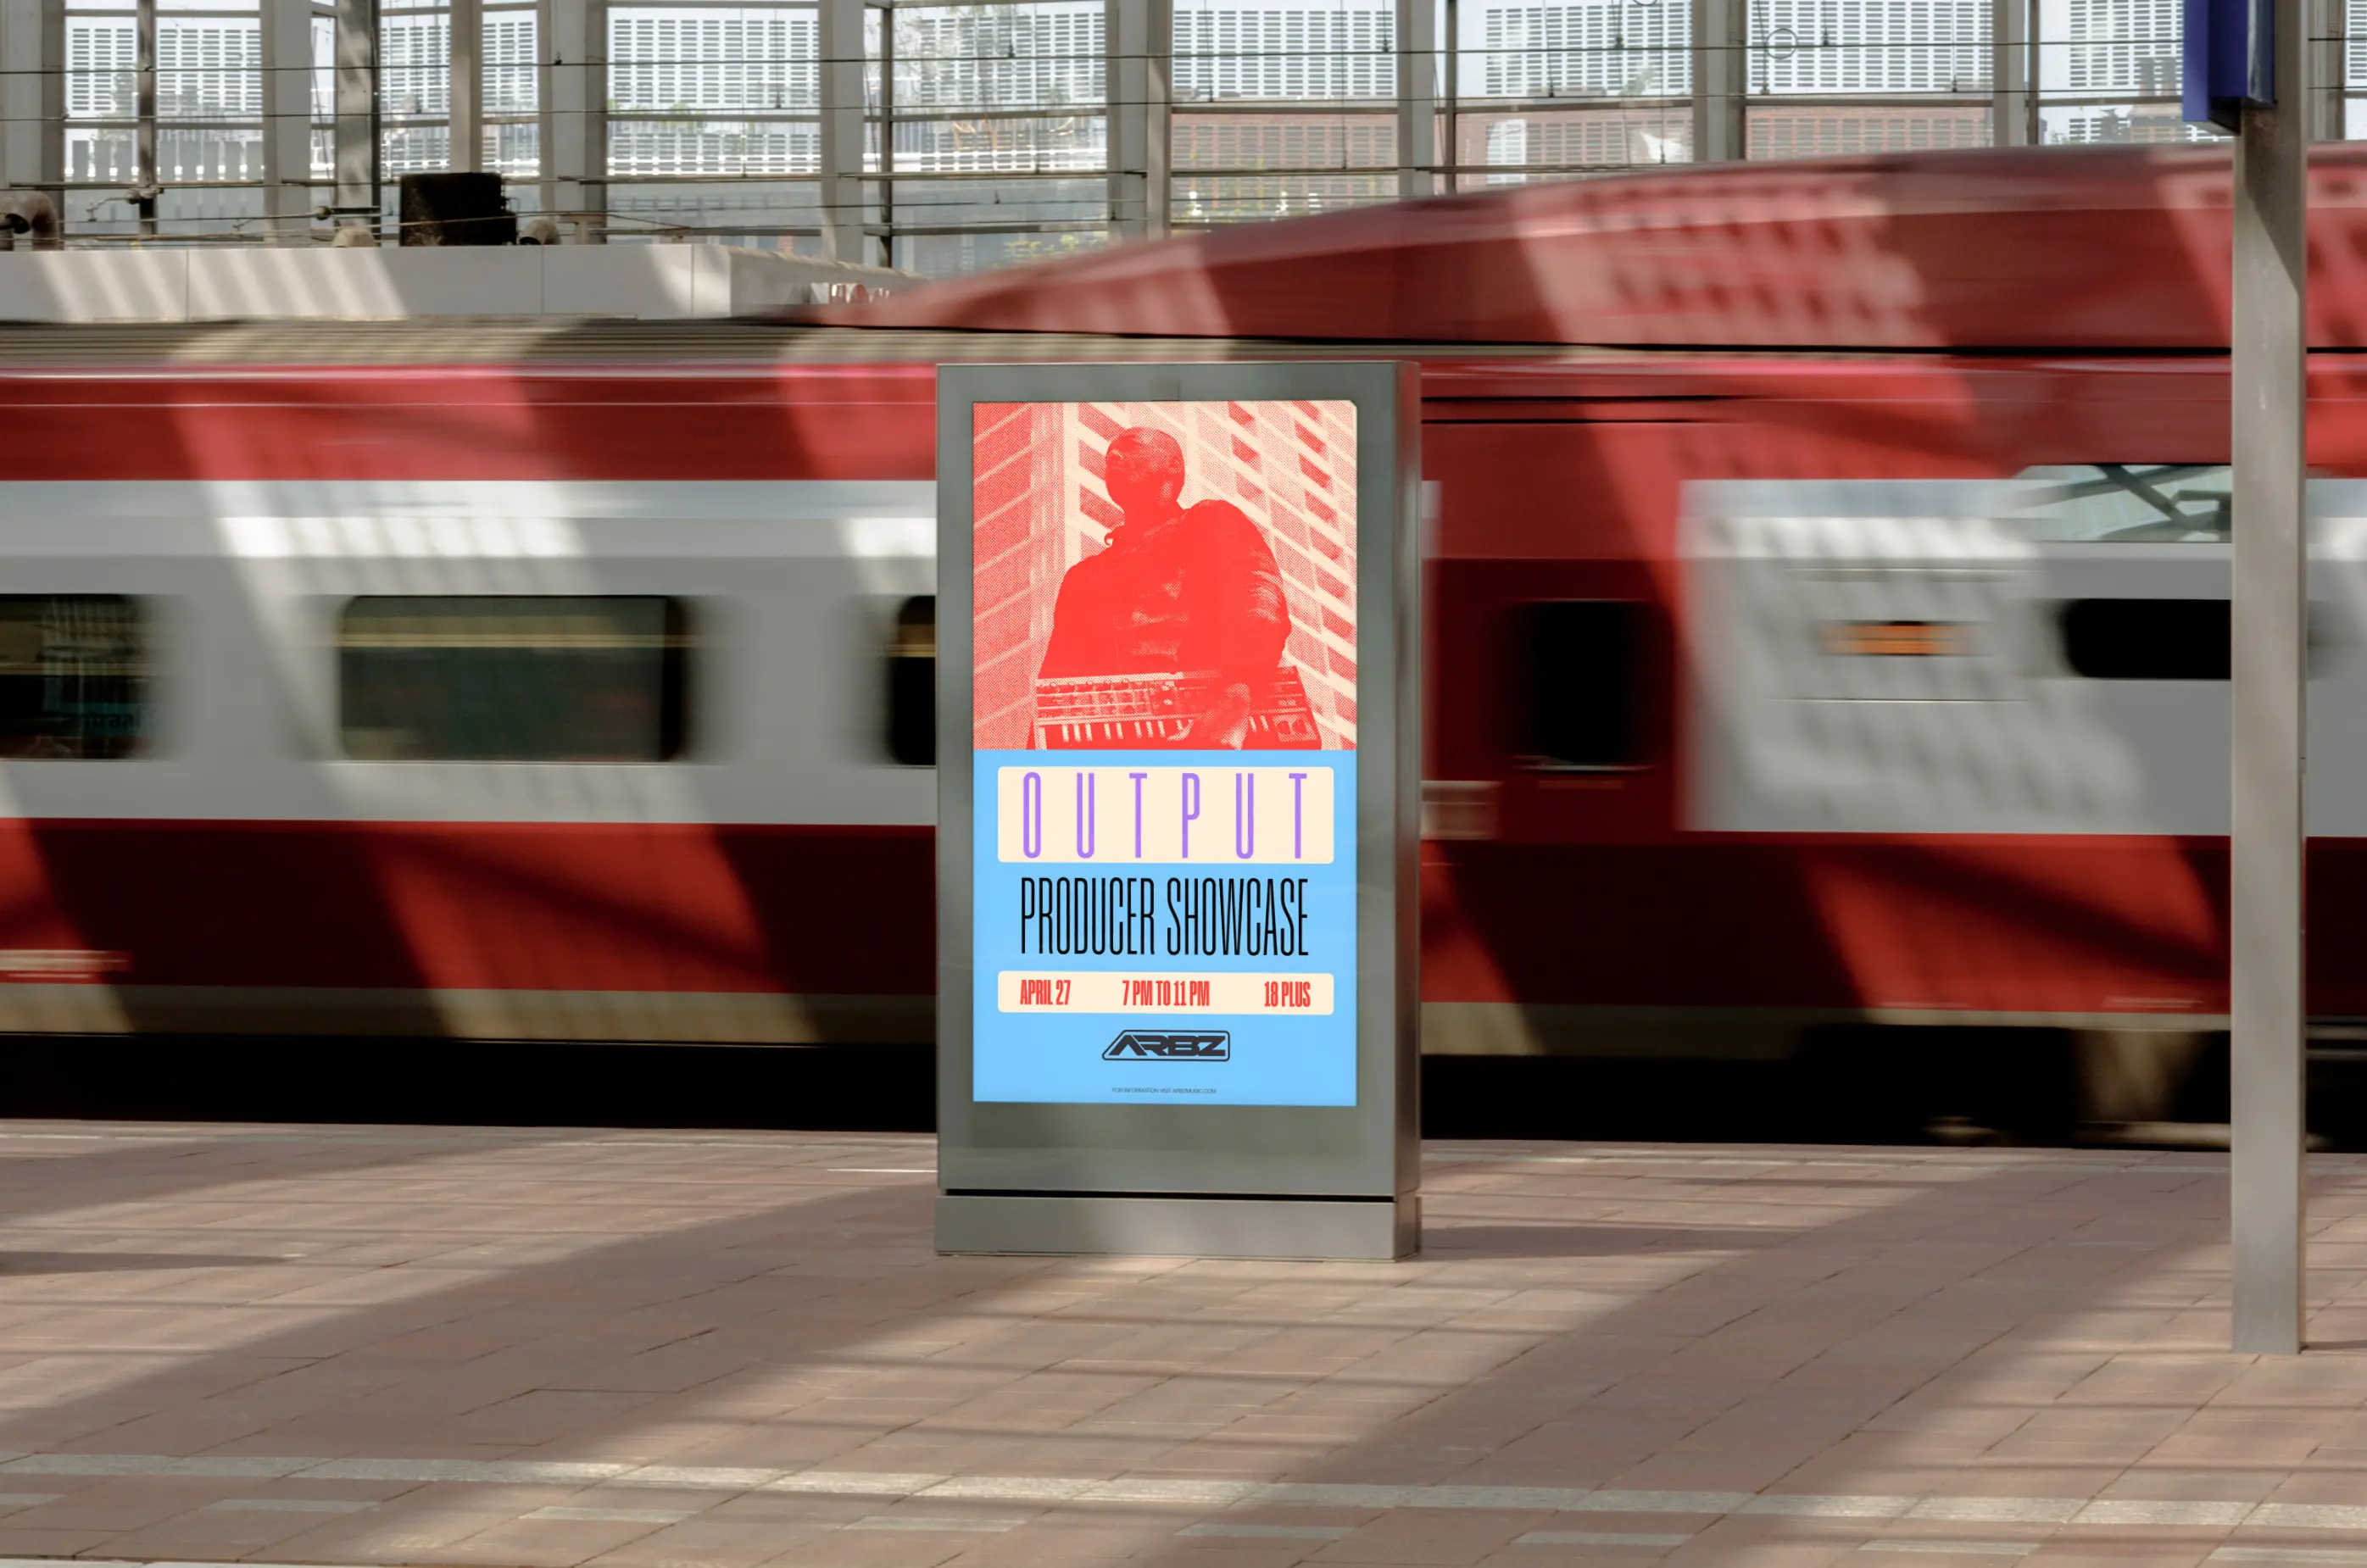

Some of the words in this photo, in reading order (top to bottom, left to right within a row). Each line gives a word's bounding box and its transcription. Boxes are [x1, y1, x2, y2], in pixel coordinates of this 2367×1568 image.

[1022, 771, 1307, 859] OUTPUT
[1022, 876, 1155, 955] PRODUCER
[1167, 877, 1309, 956] SHOWCASE
[1020, 980, 1053, 1005] APRIL
[1056, 980, 1071, 1005] 27
[1122, 980, 1130, 1006] 7
[1133, 981, 1152, 1006] PM
[1156, 981, 1171, 1006] TO
[1173, 981, 1186, 1006] 11
[1189, 981, 1210, 1007] PM
[1264, 981, 1278, 1007] 18
[1282, 981, 1311, 1007] PLUS
[1108, 1035, 1226, 1057] ARBZ
